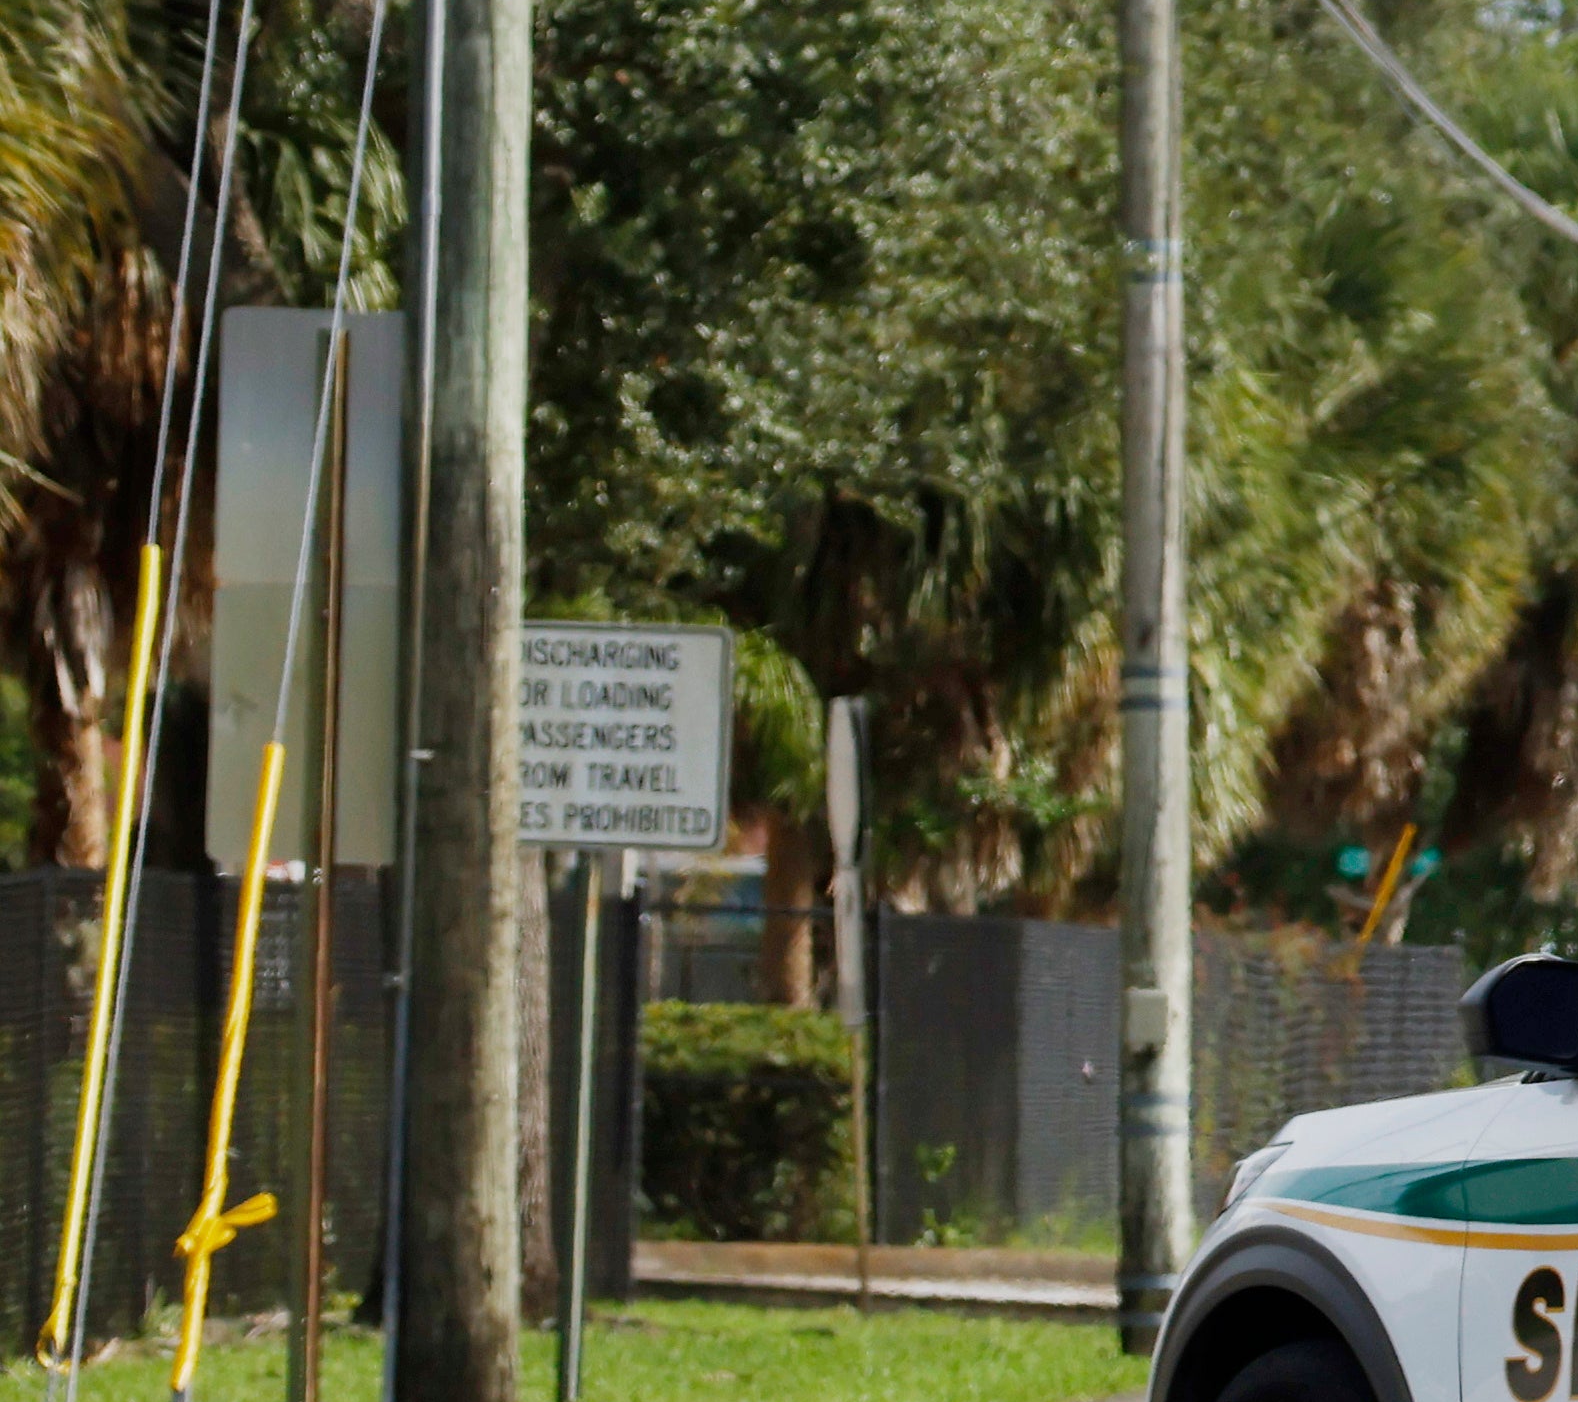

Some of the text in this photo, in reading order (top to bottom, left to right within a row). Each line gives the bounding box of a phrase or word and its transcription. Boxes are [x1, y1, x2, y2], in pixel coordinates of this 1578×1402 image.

[560, 680, 673, 712] LOADING
[520, 760, 679, 793] ROM TRAVEL
[562, 802, 712, 836] PROHIBITED
